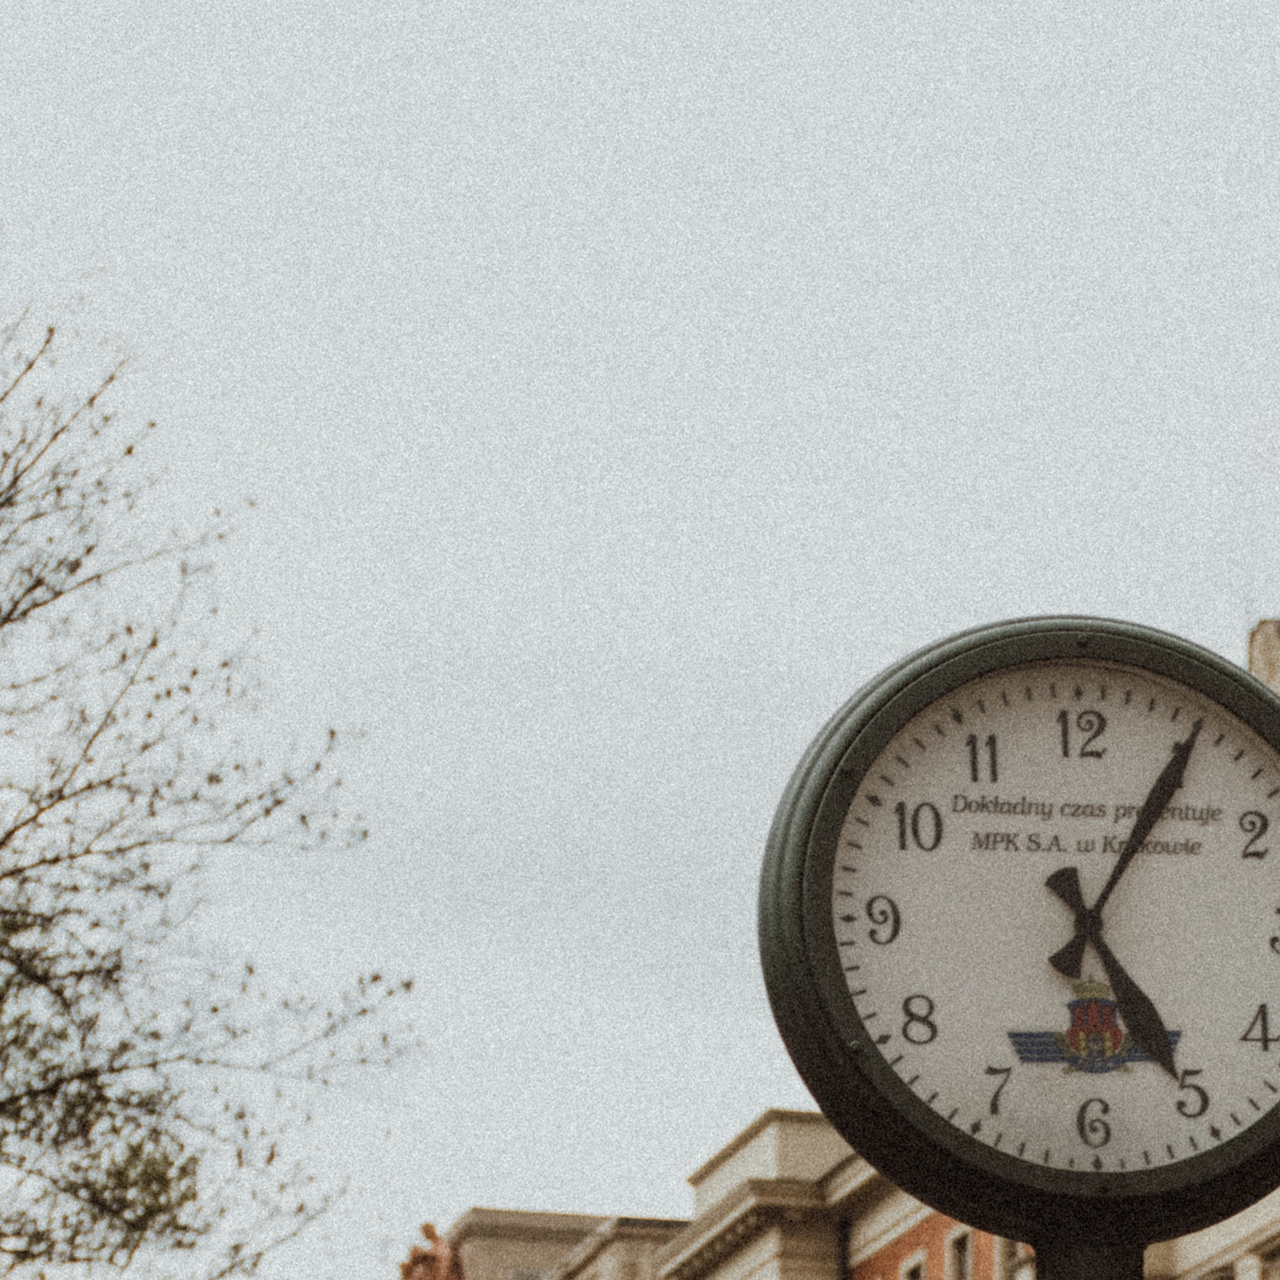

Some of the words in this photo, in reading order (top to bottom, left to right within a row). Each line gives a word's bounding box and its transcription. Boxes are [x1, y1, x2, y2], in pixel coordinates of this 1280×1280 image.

[966, 734, 998, 783] 11
[1056, 710, 1107, 759] 12
[893, 801, 944, 851] 10
[952, 793, 1053, 821] Dokładny
[1059, 802, 1107, 819] czas
[971, 831, 1020, 852] MPK
[1026, 833, 1067, 853] S.A.
[1076, 839, 1096, 854] w
[1102, 835, 1202, 856] Krkowie
[1239, 810, 1270, 860] 2
[866, 895, 901, 945] 9
[901, 995, 938, 1045] 8
[1240, 1003, 1280, 1052] 4
[984, 1065, 1012, 1116] 7
[1176, 1069, 1210, 1119] 5
[1076, 1098, 1112, 1149] 6
